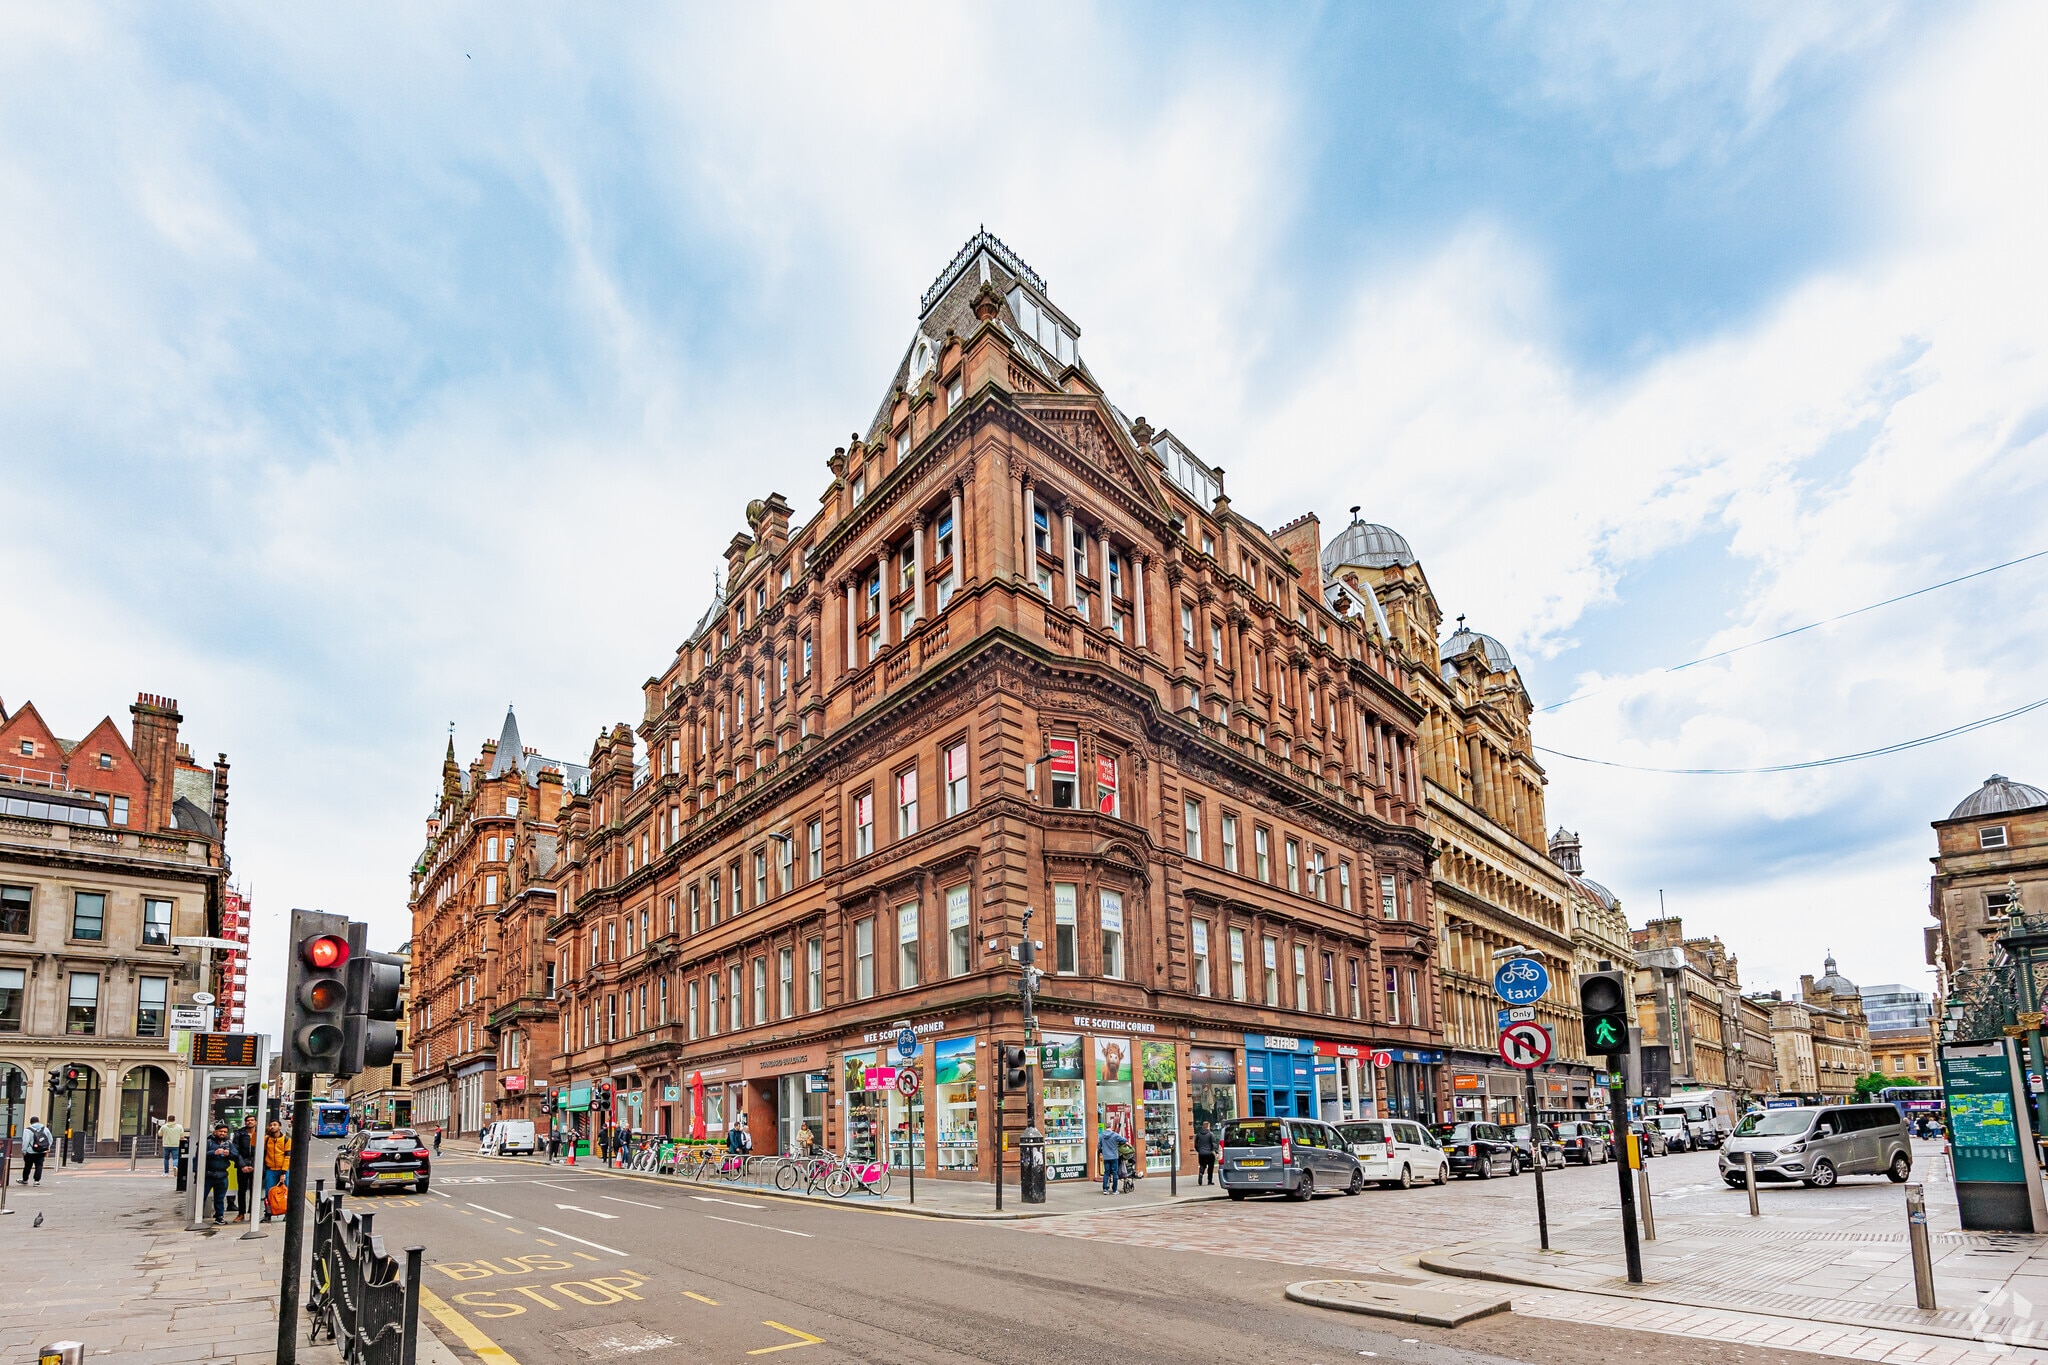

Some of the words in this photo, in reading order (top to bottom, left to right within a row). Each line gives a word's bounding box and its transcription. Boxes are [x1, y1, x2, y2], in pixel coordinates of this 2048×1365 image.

[1506, 986, 1537, 1000] taxi
[864, 1033, 877, 1042] WEE
[913, 1021, 944, 1034] CORNER
[1074, 1016, 1089, 1026] WEE
[1092, 1018, 1126, 1030] SCOTTISH
[1127, 1022, 1155, 1033] CORNER
[1669, 996, 1679, 1050] YORKSHIRE
[1264, 1036, 1299, 1050] BETFRED
[783, 1055, 807, 1066] BUILDINGS
[1379, 1053, 1386, 1066] L
[430, 1254, 575, 1281] BUS
[451, 1276, 646, 1318] STOP
